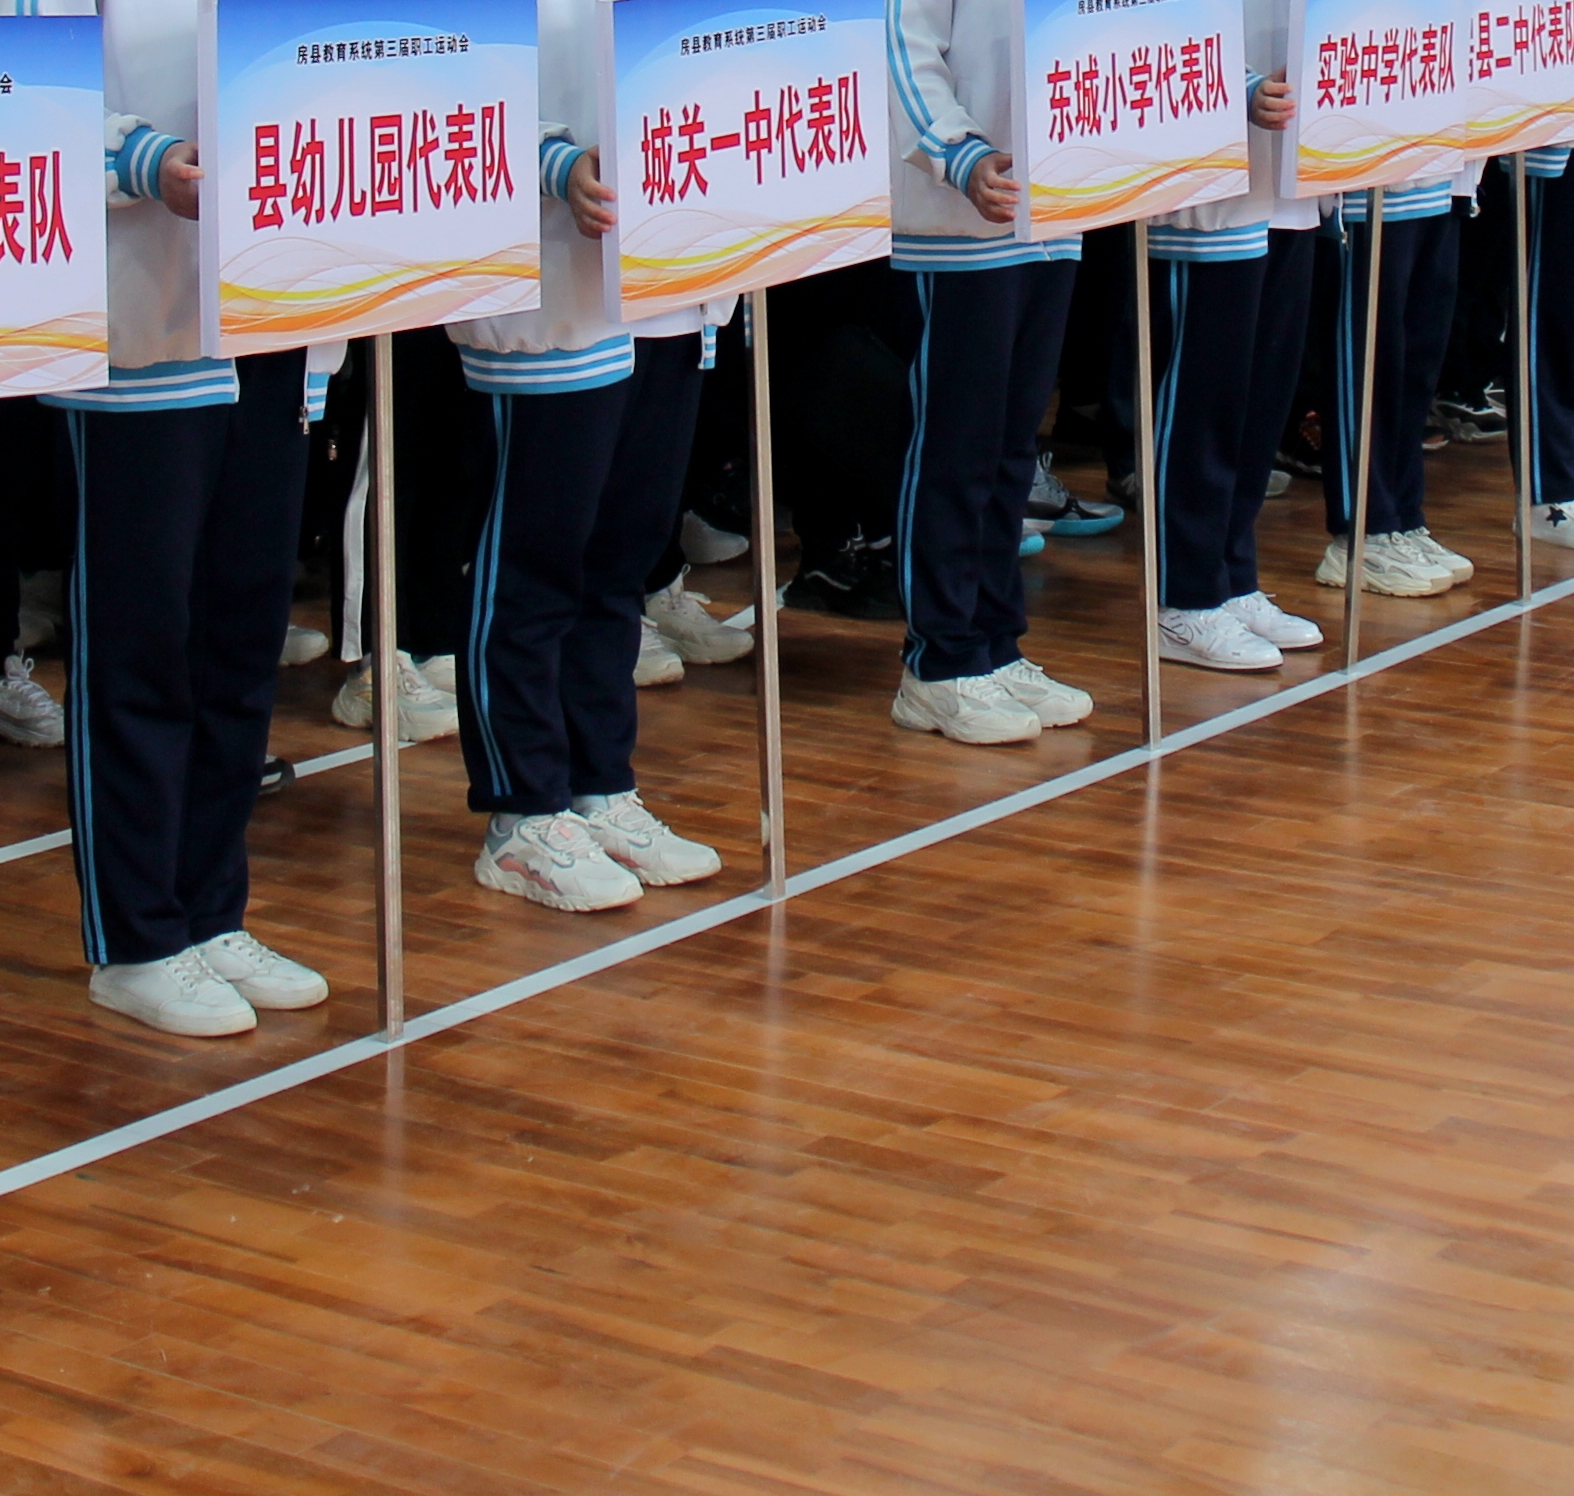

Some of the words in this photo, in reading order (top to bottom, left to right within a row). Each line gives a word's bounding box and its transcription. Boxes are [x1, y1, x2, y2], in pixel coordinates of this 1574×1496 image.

[297, 35, 468, 64] 房县教育系统第三届职工运动会
[681, 15, 826, 55] 房县教育系统第三届职工运动会
[1317, 22, 1455, 109] 实验中学代表队
[641, 71, 868, 205] 城关一中代表队
[1047, 33, 1229, 144] 东城小学代表队
[248, 101, 514, 231] 县幼儿园代表队
